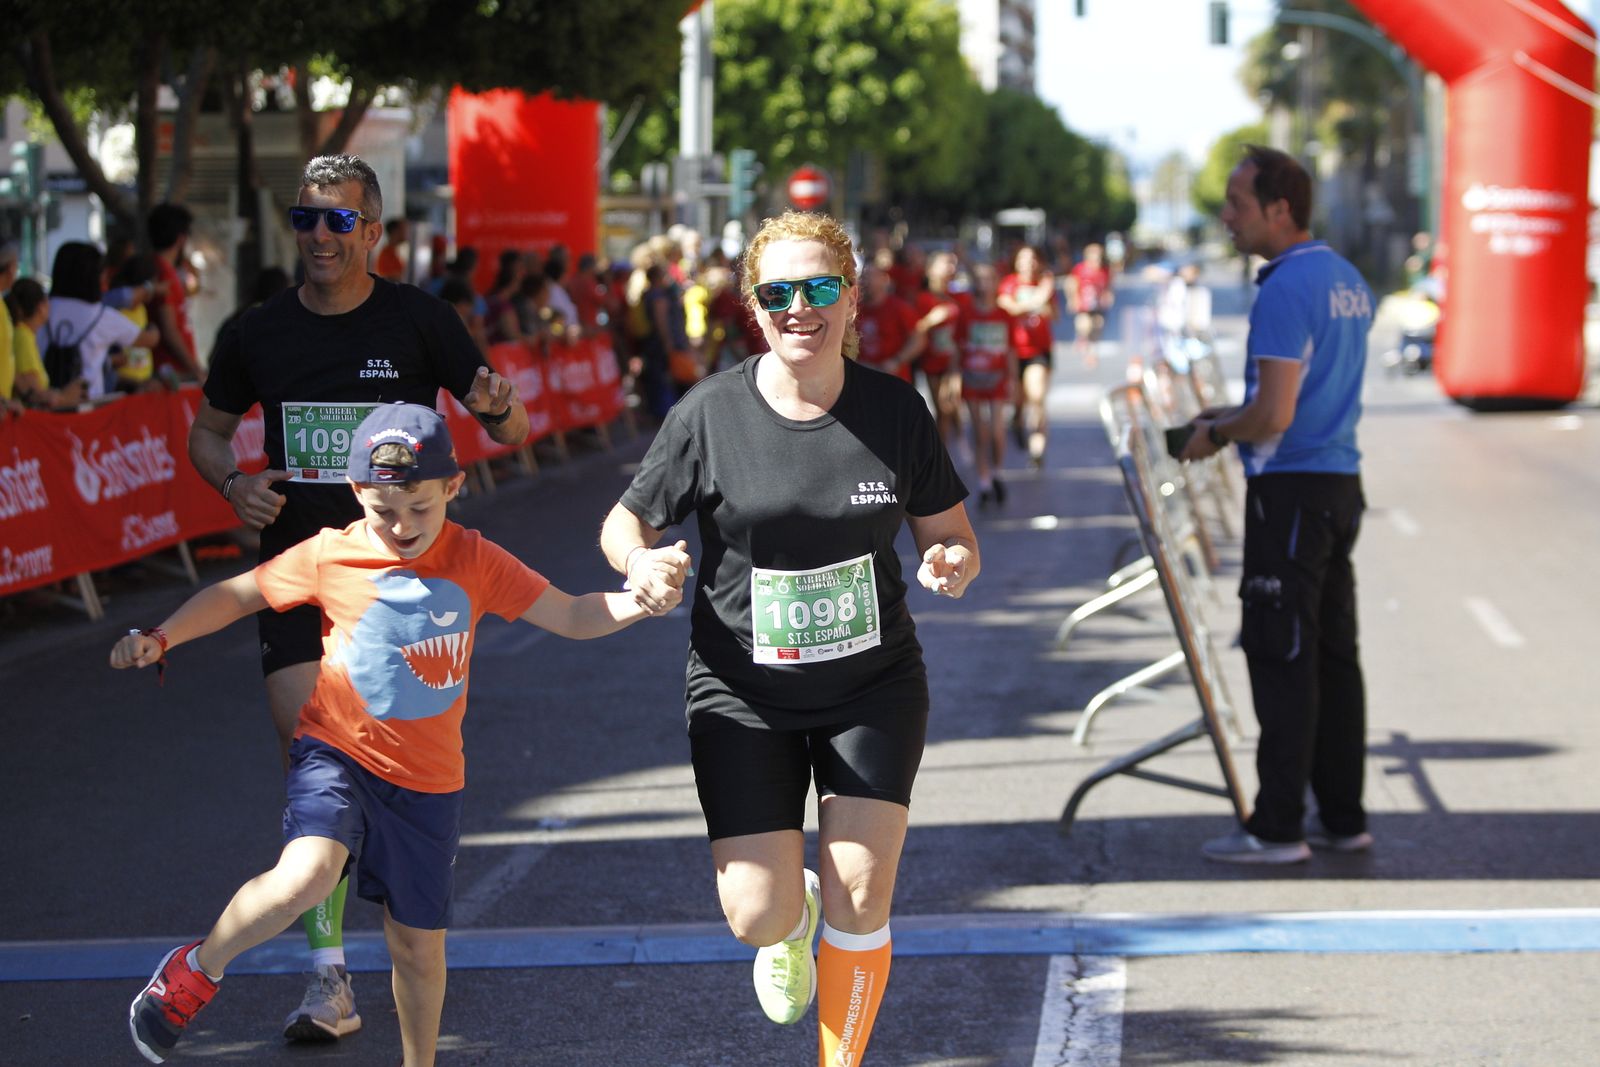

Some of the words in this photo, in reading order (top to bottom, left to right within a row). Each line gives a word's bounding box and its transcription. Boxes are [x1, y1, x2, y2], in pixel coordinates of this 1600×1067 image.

[367, 359, 393, 368] S.T.S.
[359, 368, 399, 379] ESPAÑA
[319, 407, 357, 415] CARRERA
[295, 428, 357, 453] 109
[310, 455, 330, 467] S.T.S.
[858, 481, 888, 492] S.T.S.
[850, 491, 898, 504] ESPAÑA
[795, 570, 841, 585] CARRERA
[795, 580, 842, 593] SOLIDARIA
[766, 592, 857, 629] 1098
[787, 632, 813, 645] S.T.S.
[815, 623, 852, 643] ESPAÑA
